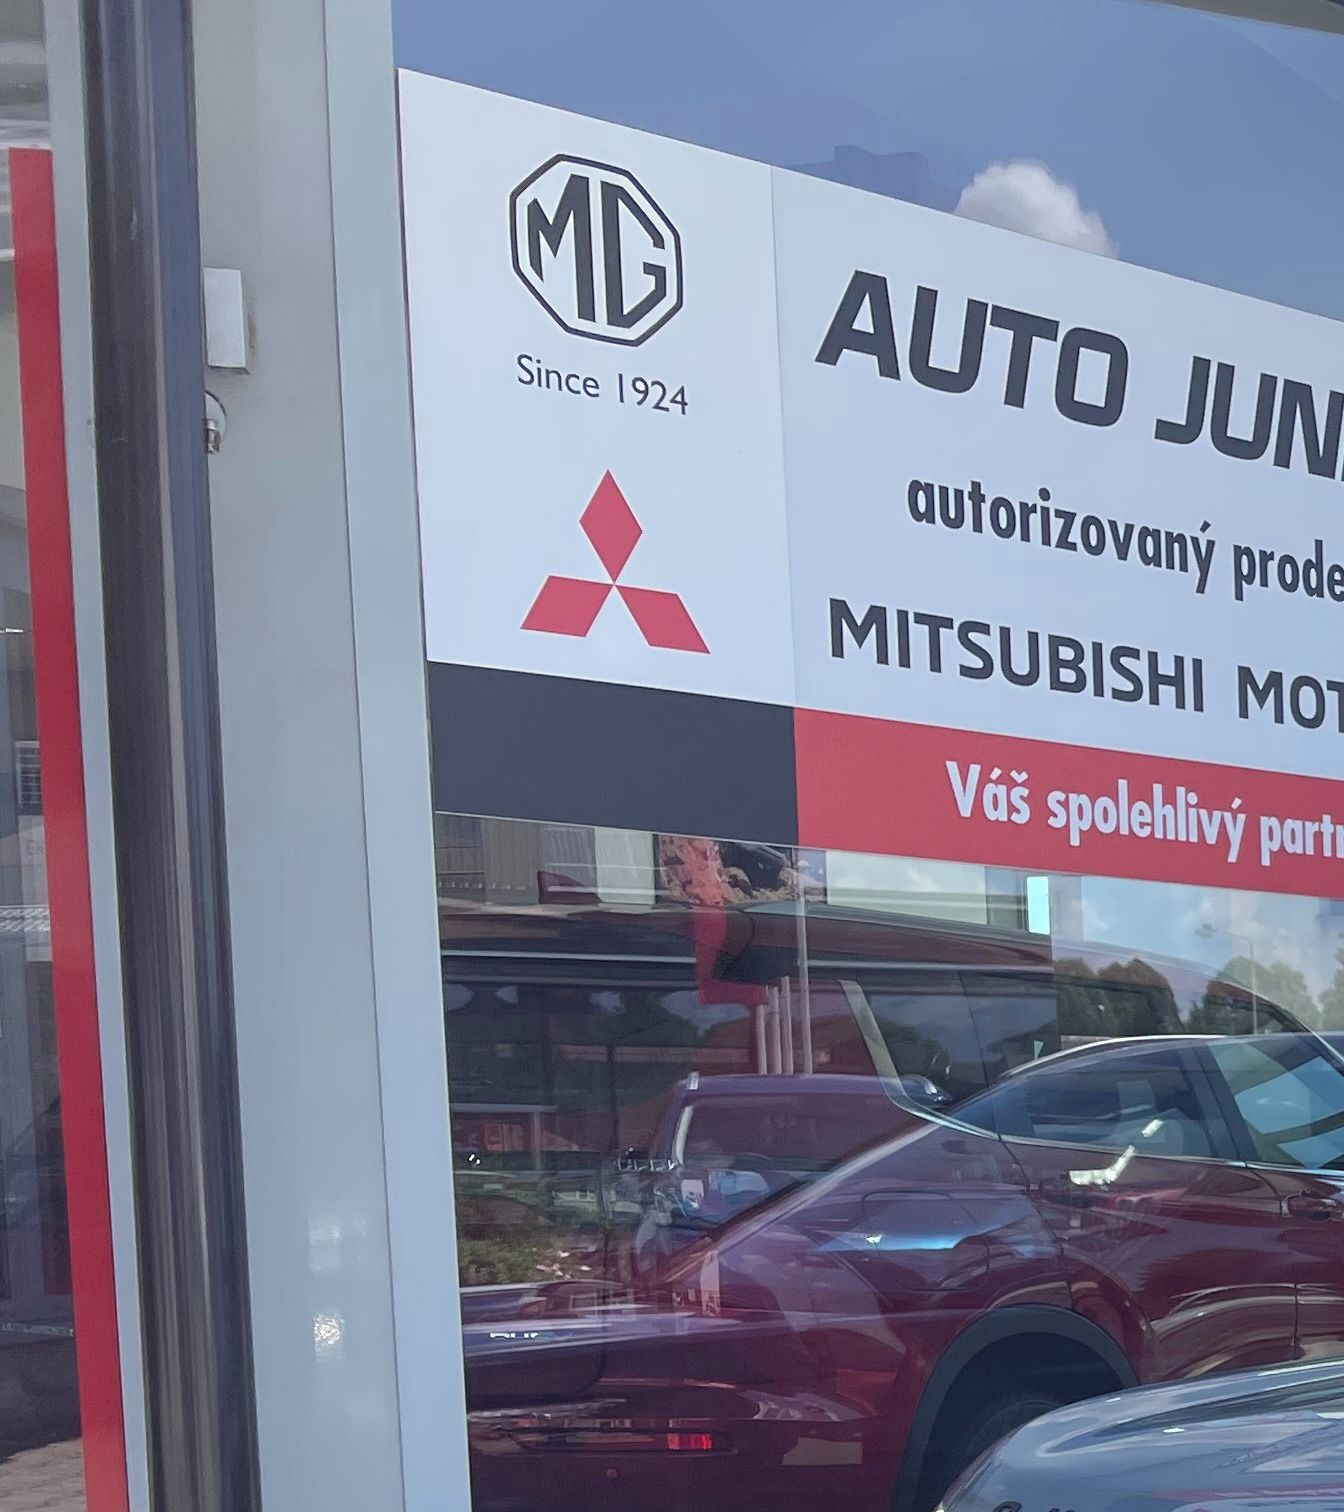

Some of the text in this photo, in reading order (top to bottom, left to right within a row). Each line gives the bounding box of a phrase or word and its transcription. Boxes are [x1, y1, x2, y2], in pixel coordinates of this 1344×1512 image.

[526, 172, 668, 329] MG
[517, 353, 689, 416] Since 1924
[813, 269, 1129, 428] AUTO
[907, 479, 1216, 595] autorizovaný
[829, 597, 1205, 713] MITSUBISHI
[945, 760, 1031, 825] Váš
[1046, 778, 1247, 863] spolehlivý
